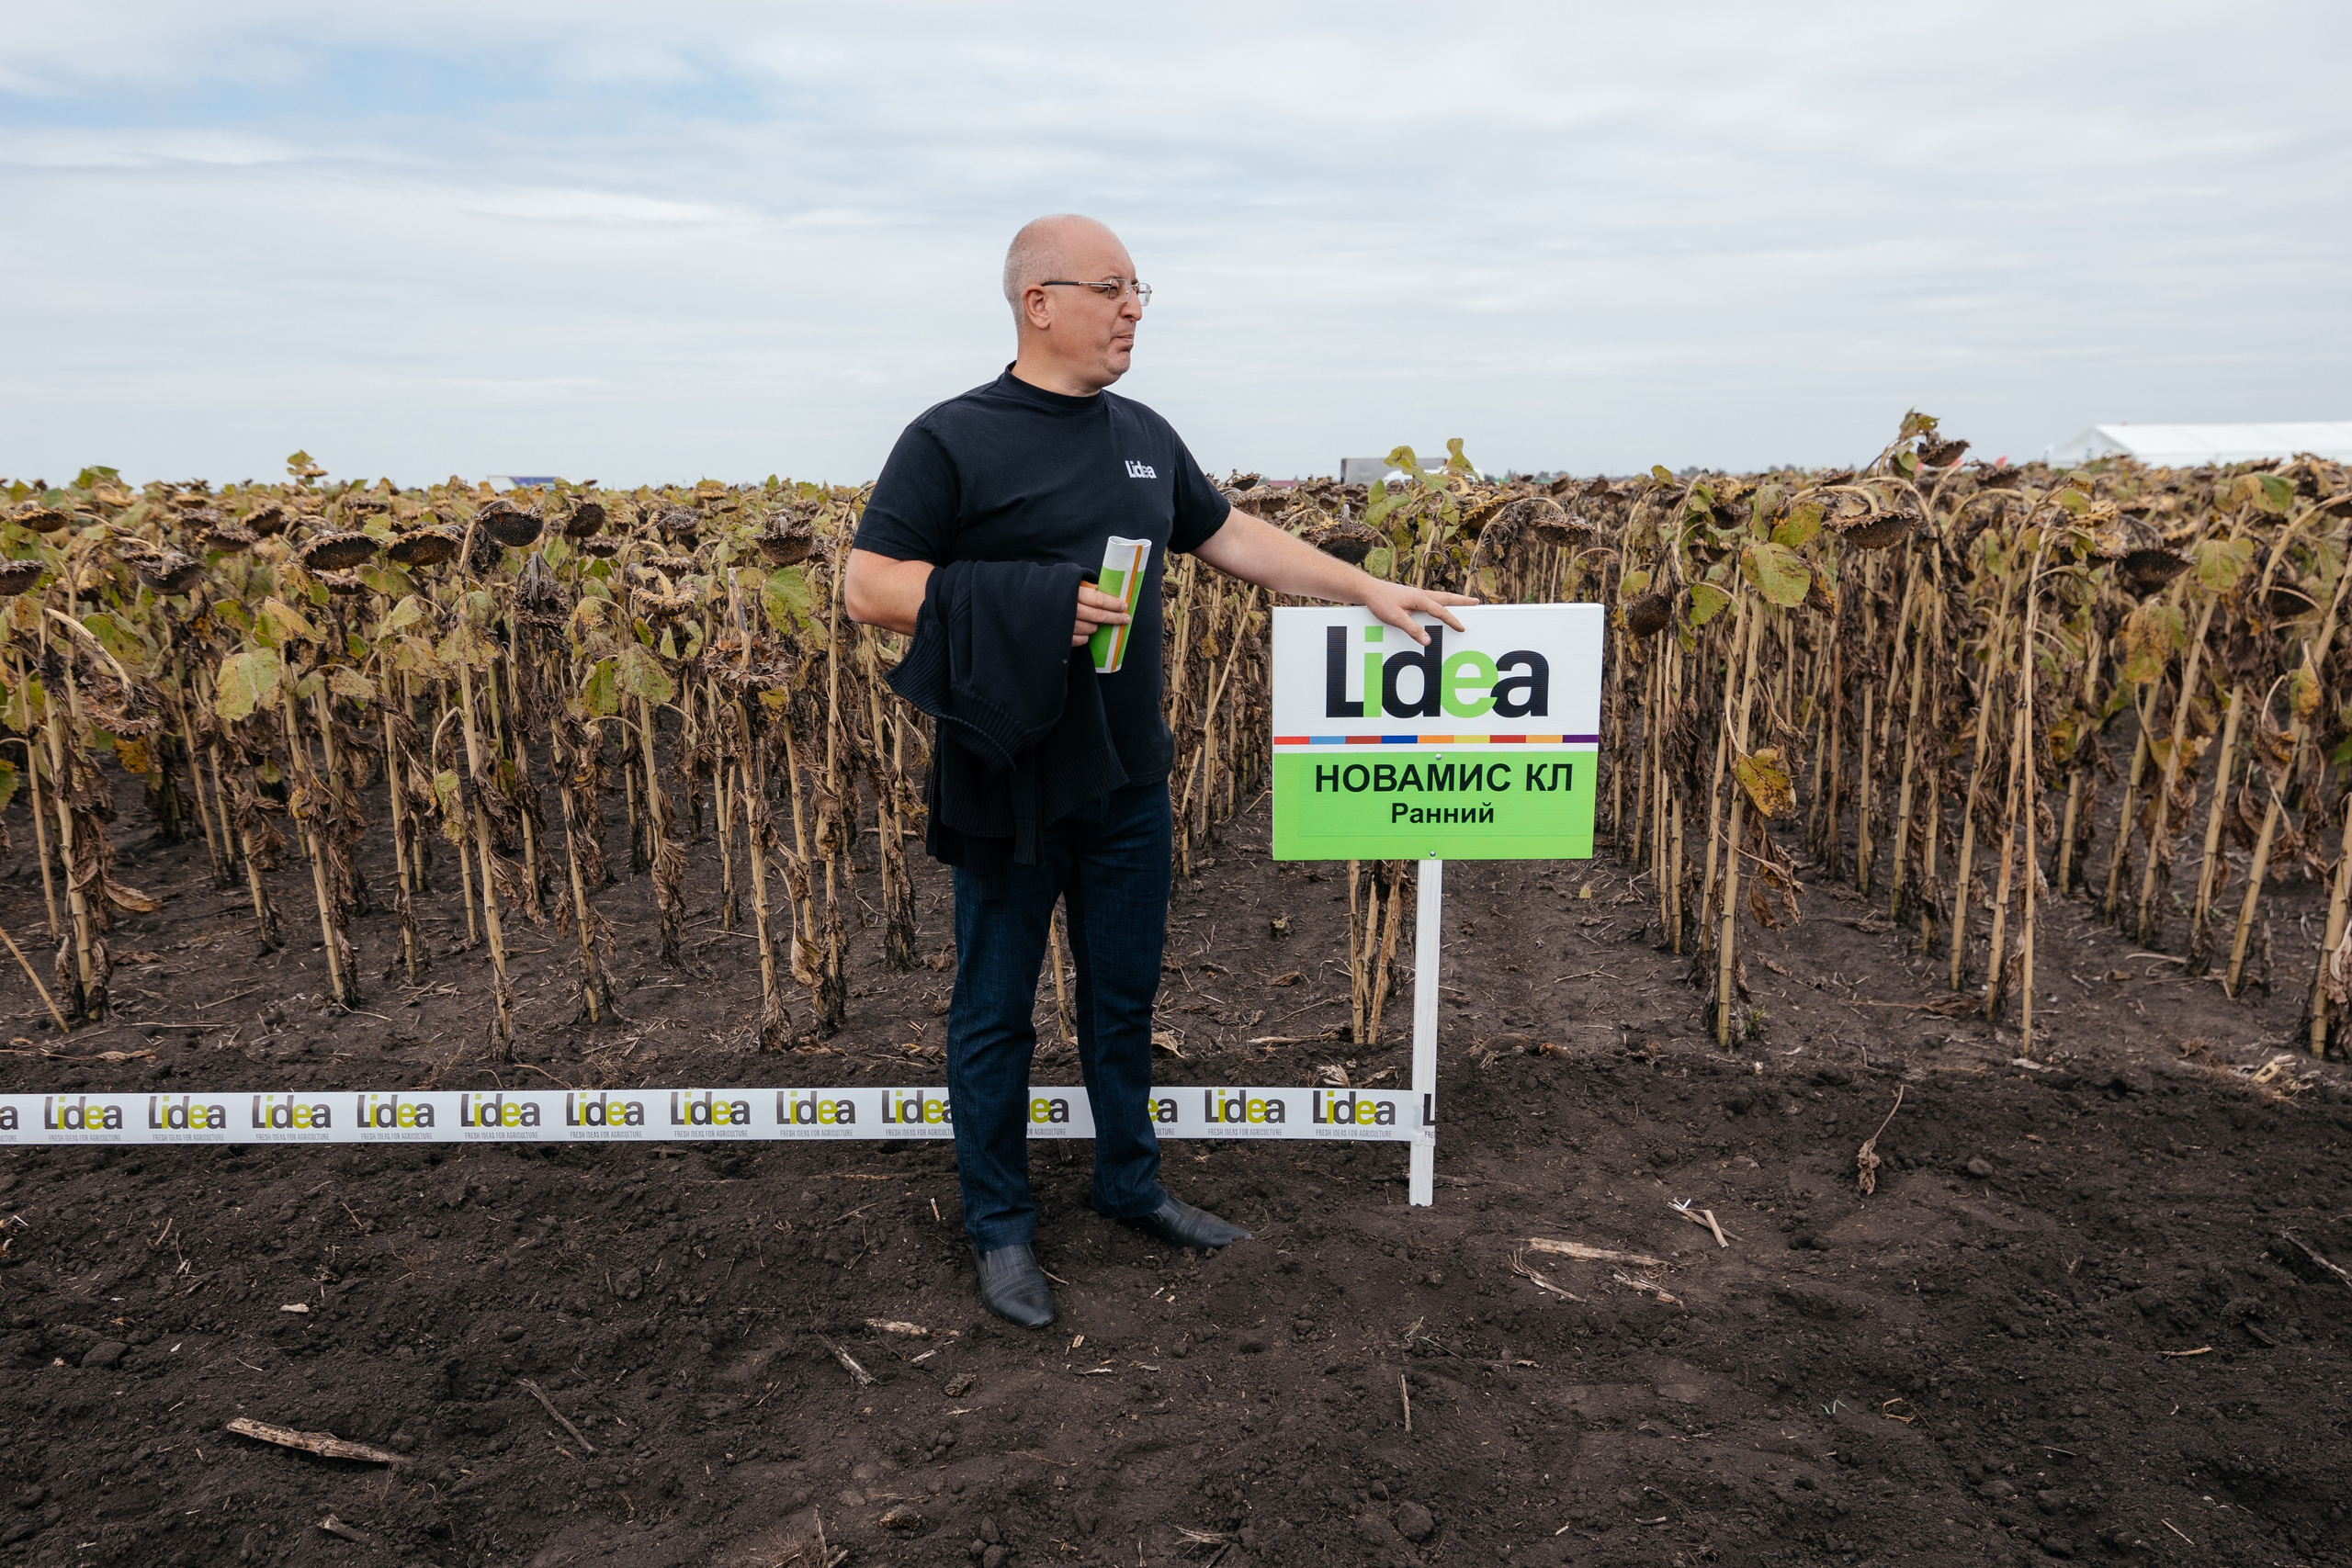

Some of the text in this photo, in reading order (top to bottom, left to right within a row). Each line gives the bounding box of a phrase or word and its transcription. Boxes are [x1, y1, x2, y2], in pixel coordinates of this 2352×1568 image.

[1125, 460, 1158, 479] Lidea
[1326, 626, 1550, 719] Lidea
[1315, 763, 1573, 793] НОВАМИС КЛ
[1391, 801, 1495, 824] Ранний
[44, 1096, 123, 1130] Lidea
[149, 1096, 227, 1129] Lidea
[253, 1095, 332, 1129] Lidea
[357, 1095, 435, 1129] Lidea
[460, 1094, 540, 1128] Lidea
[566, 1093, 645, 1127] Lidea
[671, 1092, 751, 1126] Lidea
[775, 1091, 856, 1125] Lidea
[1204, 1089, 1285, 1123] Lidea
[1313, 1090, 1396, 1125] Lidea
[1035, 1127, 1067, 1135] AGRICULTURE
